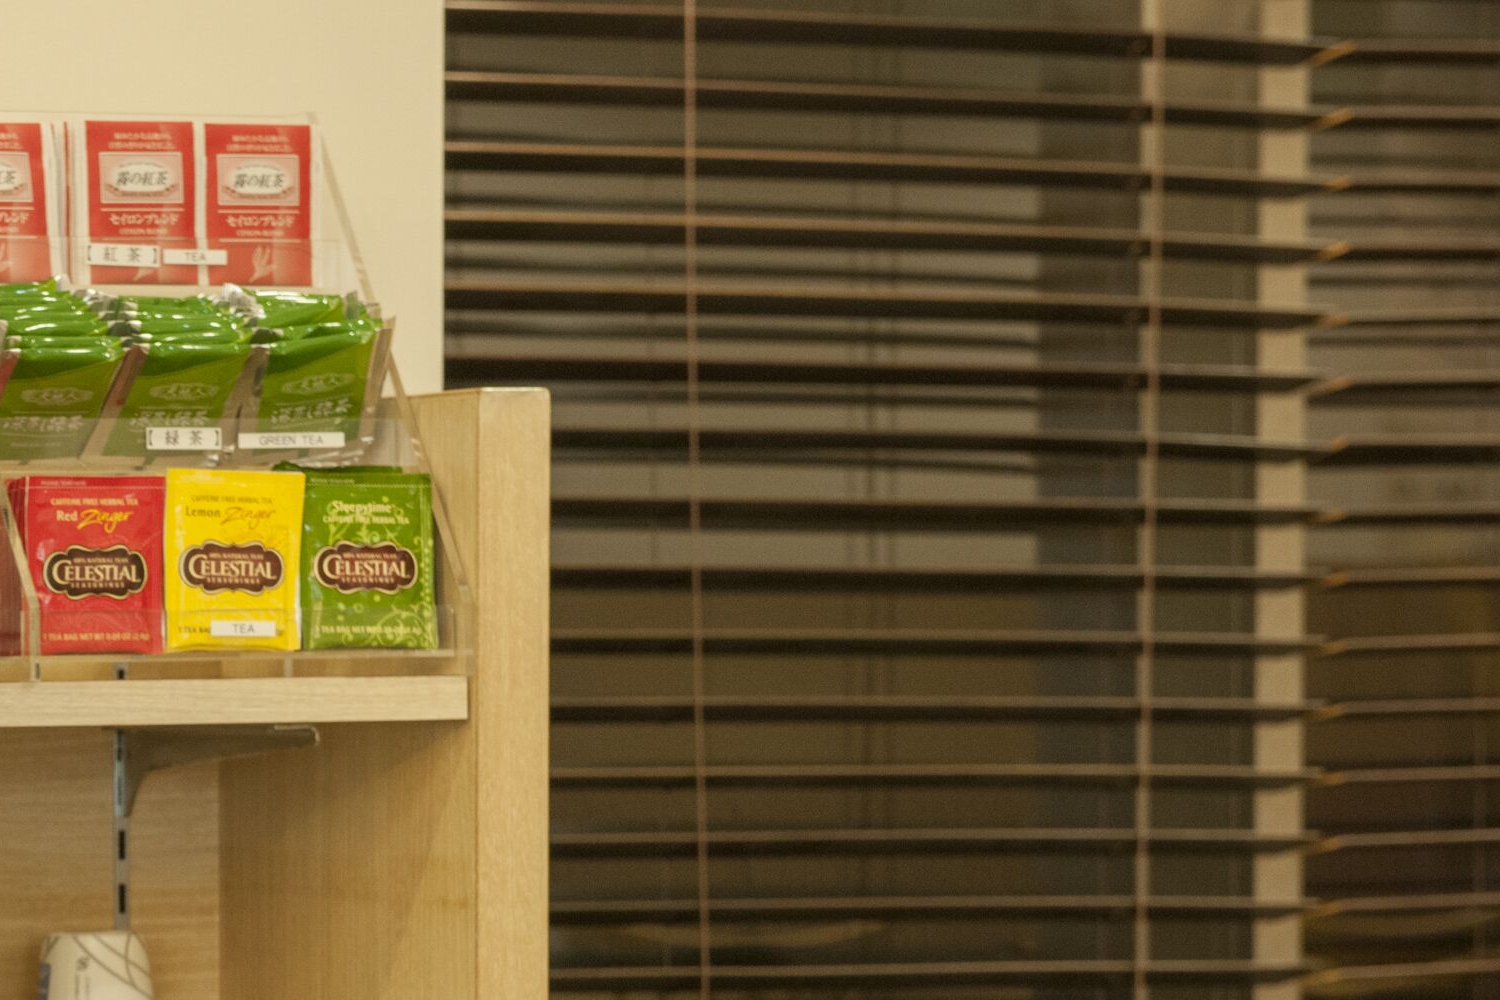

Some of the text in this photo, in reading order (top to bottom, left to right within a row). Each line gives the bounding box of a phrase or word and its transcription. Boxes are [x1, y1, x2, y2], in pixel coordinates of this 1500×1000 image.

[184, 251, 206, 262] TEA
[259, 435, 325, 446] GREEN TEA
[56, 508, 134, 534] Red Zinger
[185, 505, 277, 530] Lemon Zinger
[52, 559, 141, 585] CELESTIAL
[188, 553, 277, 579] CELESTIAL
[323, 553, 411, 579] CELESTIAL
[232, 623, 255, 633] TEA
